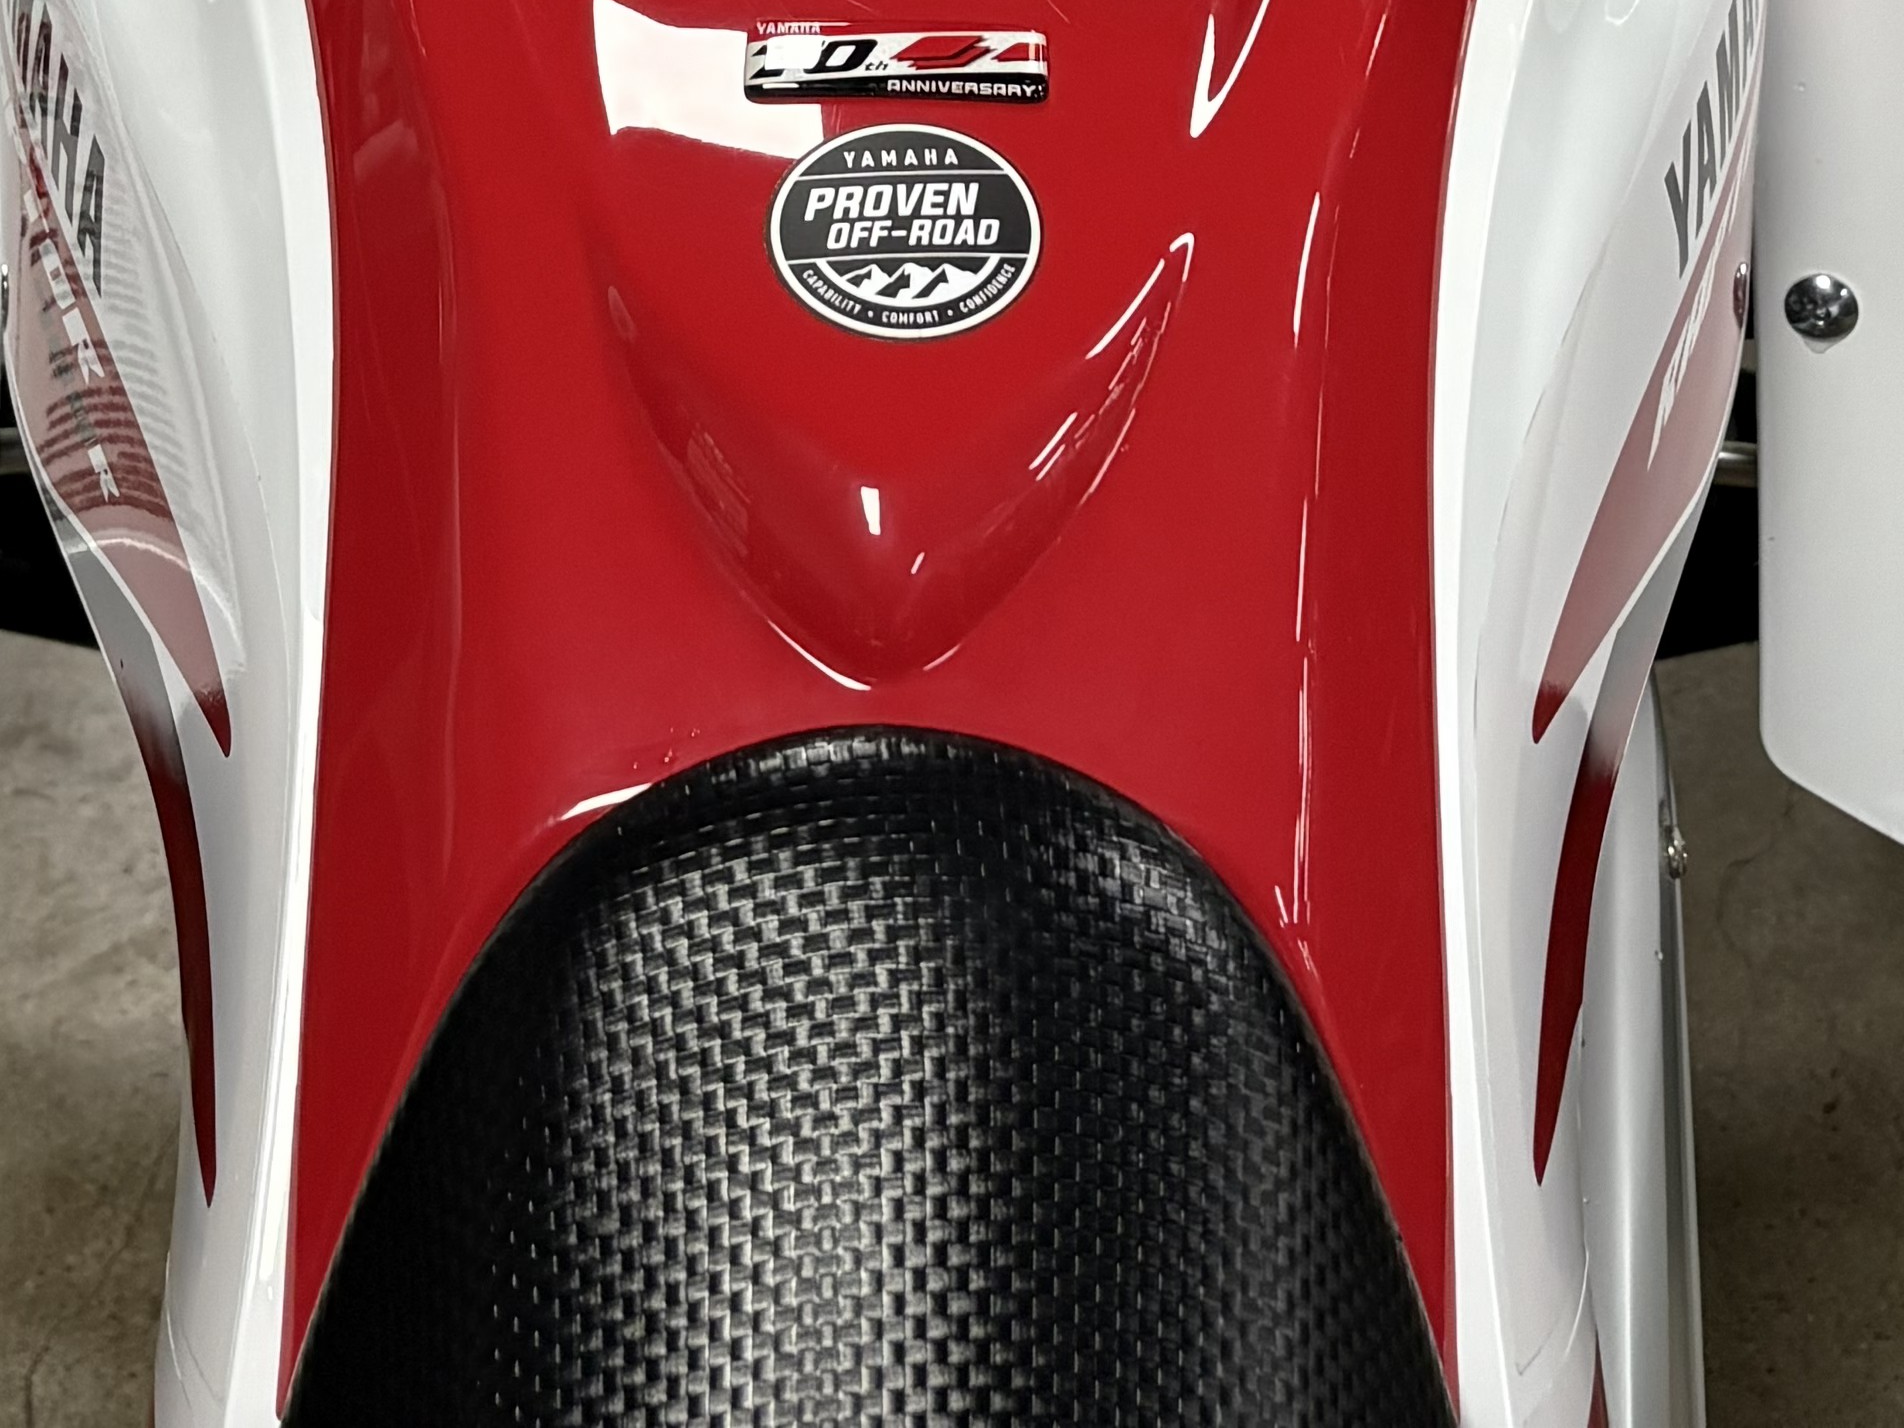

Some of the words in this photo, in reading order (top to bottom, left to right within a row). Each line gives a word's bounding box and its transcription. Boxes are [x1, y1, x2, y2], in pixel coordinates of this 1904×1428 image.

[757, 21, 821, 34] YAMAHA
[887, 79, 1036, 97] ANNIVERSARY
[843, 147, 959, 168] YAMAHA
[804, 182, 980, 221] PROVEN
[826, 218, 1000, 250] OFF-ROAD
[802, 268, 861, 315] CAPABILITY
[882, 310, 940, 324] COMFORT
[959, 263, 1017, 314] CONFIDENCE
